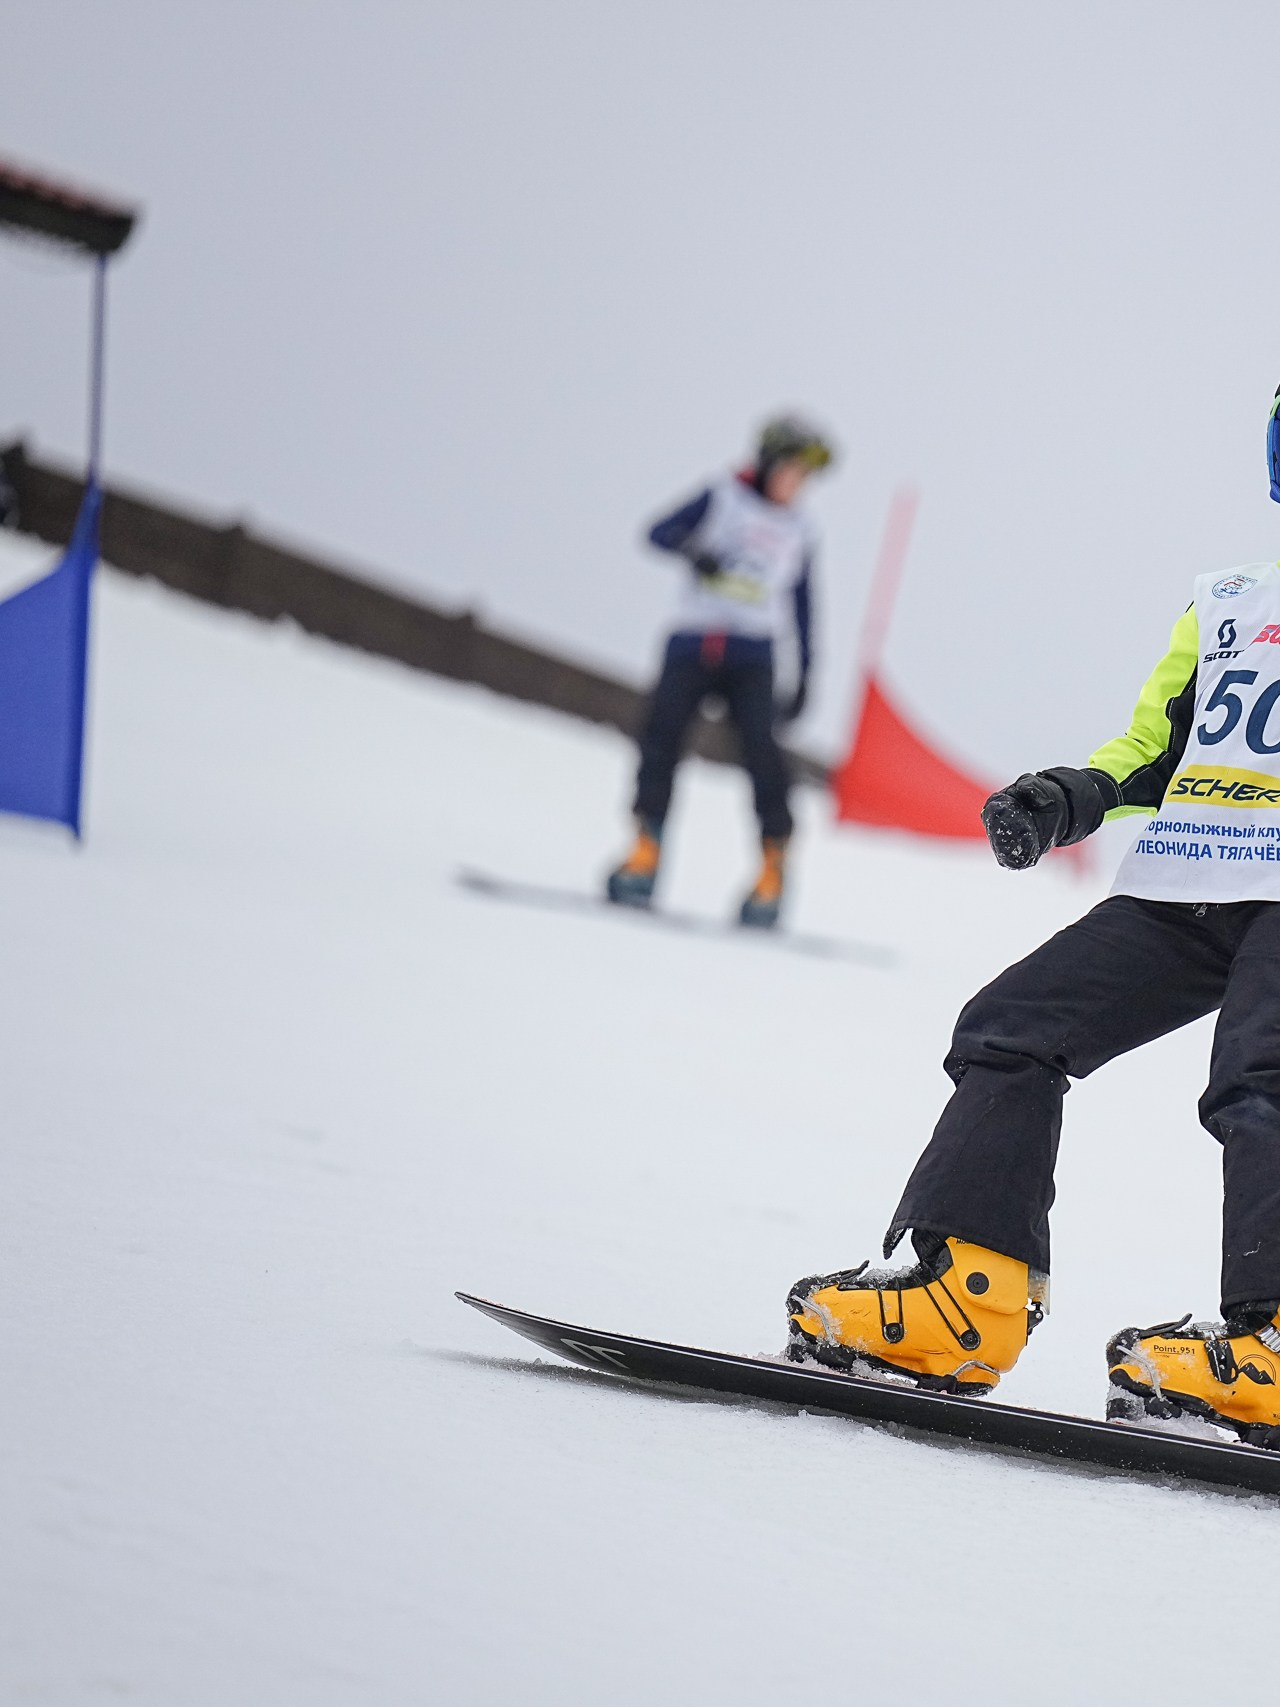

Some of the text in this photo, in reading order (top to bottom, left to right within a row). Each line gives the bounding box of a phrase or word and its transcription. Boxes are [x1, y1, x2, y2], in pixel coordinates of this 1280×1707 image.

[1203, 650, 1245, 663] SCOT
[1145, 820, 1255, 838] орнолыжный
[1135, 839, 1213, 860] ЛЕОНИДА
